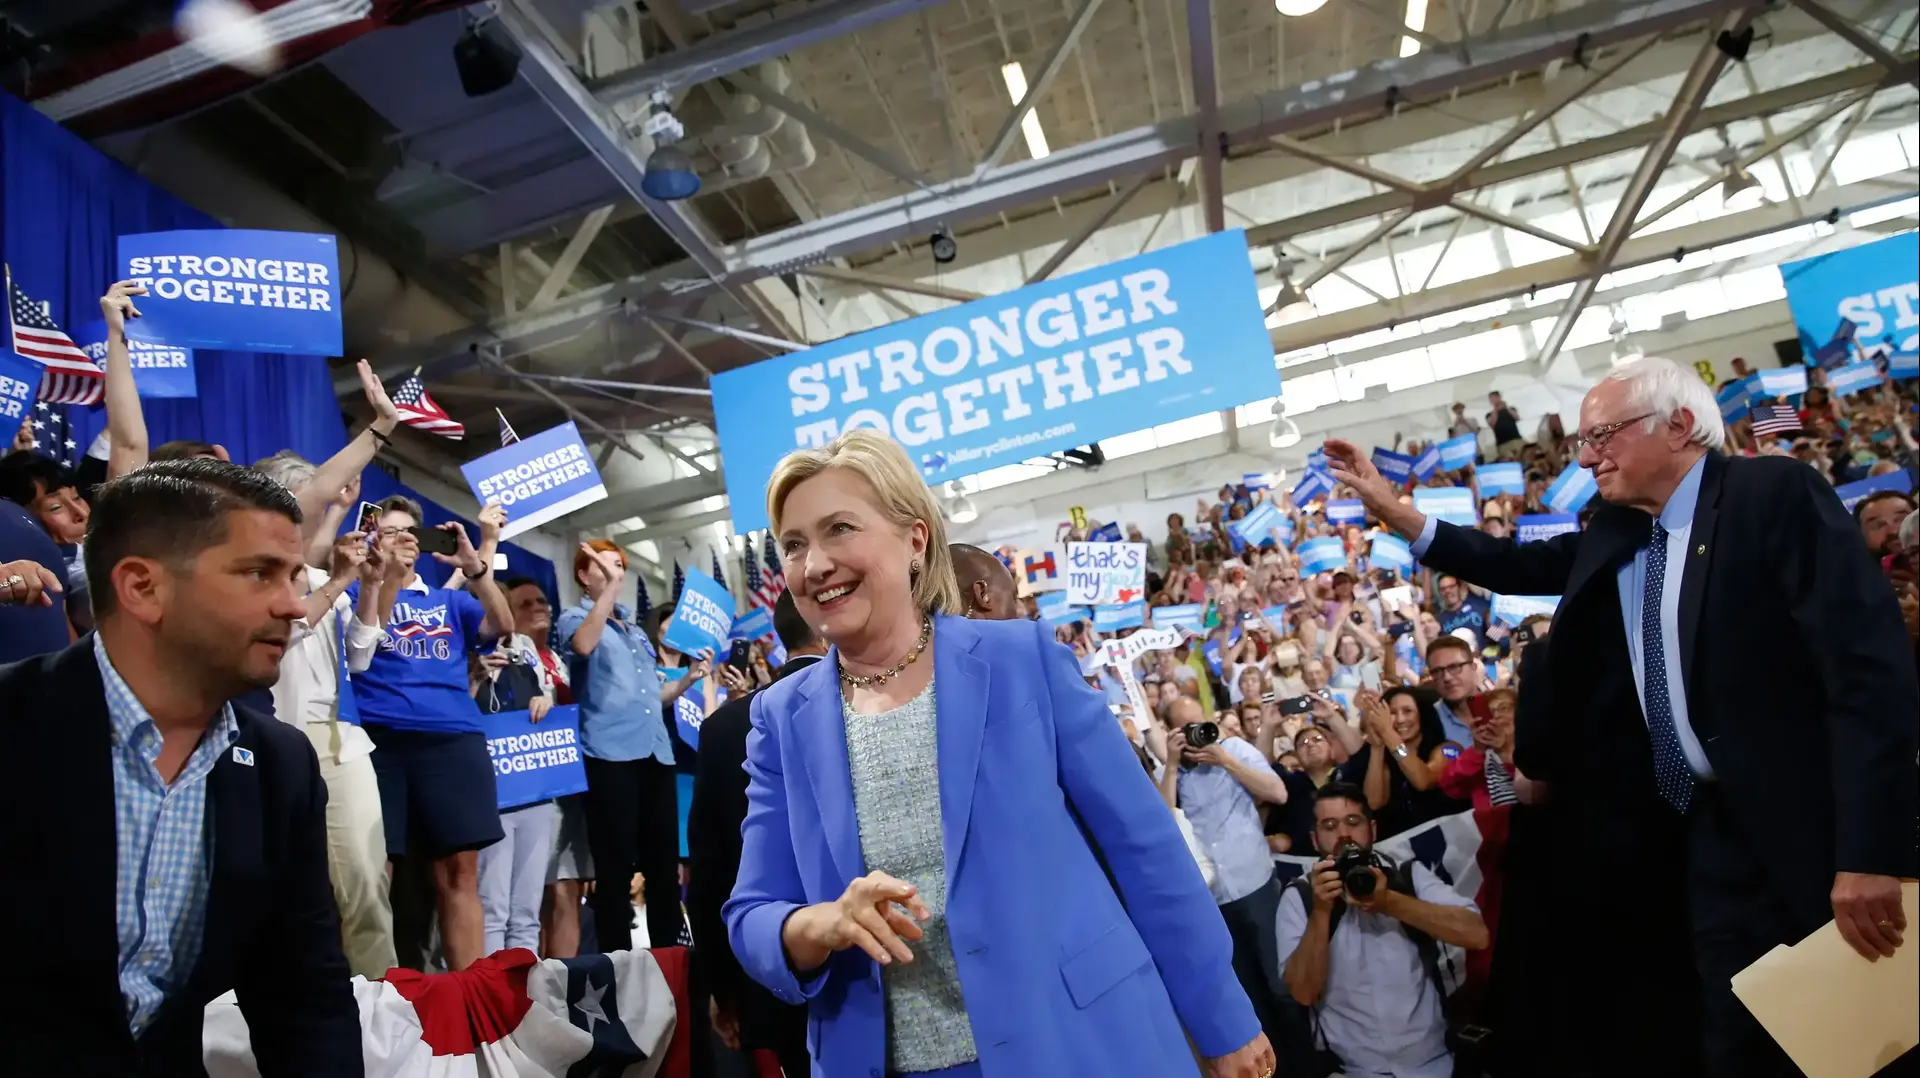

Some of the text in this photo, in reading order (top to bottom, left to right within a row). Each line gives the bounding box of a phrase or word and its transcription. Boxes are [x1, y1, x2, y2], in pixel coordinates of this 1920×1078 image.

[130, 255, 330, 285] STRONGER
[130, 277, 332, 311] TOGETHER
[788, 268, 1178, 416] STRONGER
[947, 422, 1077, 465] hillaryclinton.com
[478, 443, 584, 496] STRONGER
[1070, 506, 1088, 529] B
[1069, 545, 1140, 570] that's
[1070, 572, 1100, 600] my
[379, 635, 450, 660] 2016
[1106, 633, 1175, 663] Hillary
[486, 728, 576, 757] STRONGER
